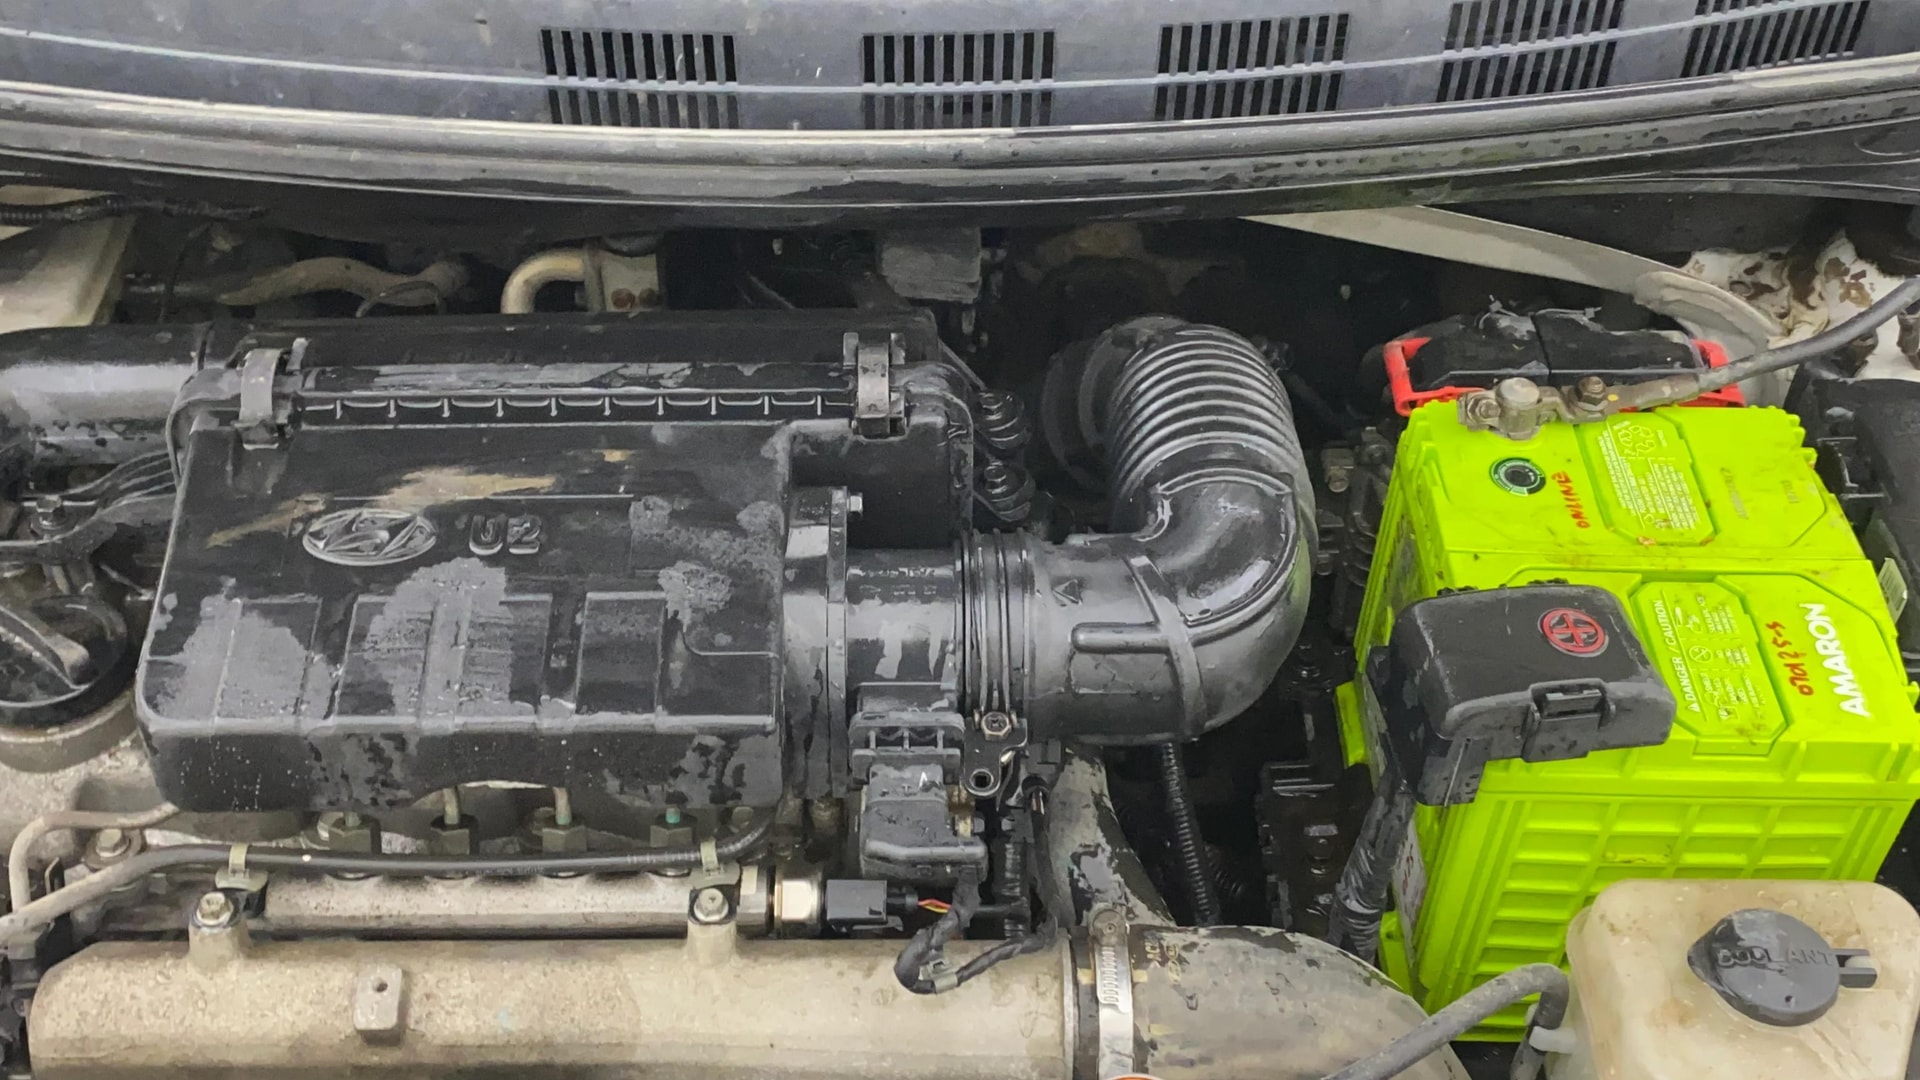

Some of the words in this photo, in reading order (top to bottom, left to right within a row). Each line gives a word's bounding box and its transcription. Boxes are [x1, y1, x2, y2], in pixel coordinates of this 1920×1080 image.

[1552, 471, 1591, 529] ONLINE
[469, 513, 542, 556] U2
[1653, 599, 1677, 646] CAUTION
[1671, 656, 1697, 702] DANGER
[1799, 602, 1872, 718] AMARON
[1715, 947, 1832, 969] COOLANT
